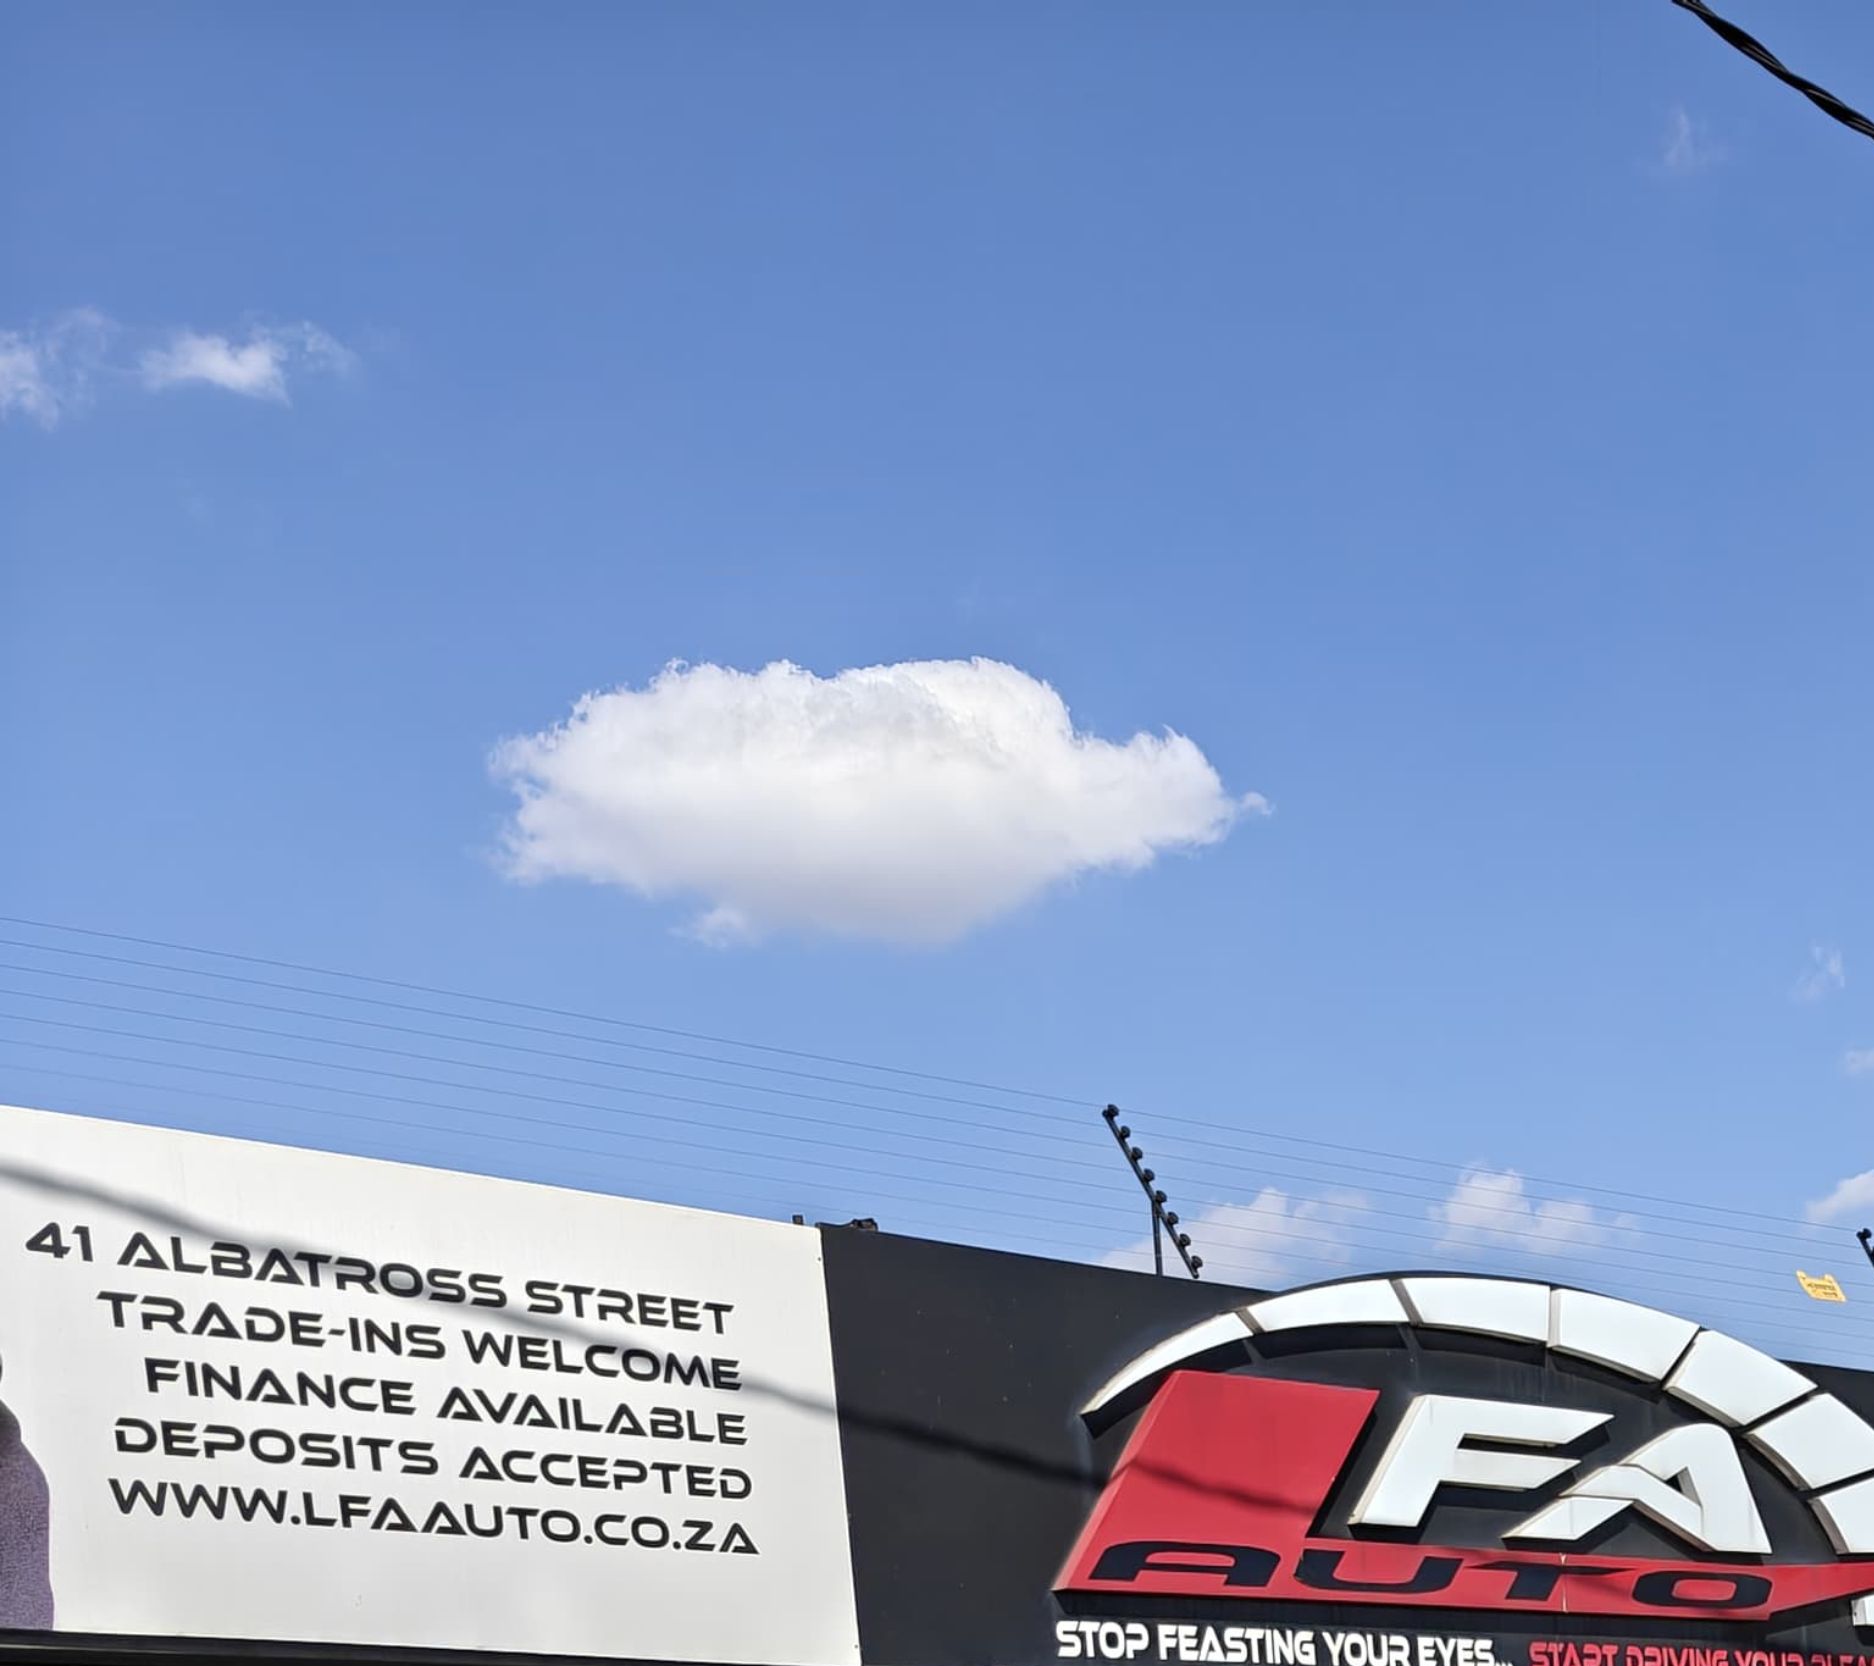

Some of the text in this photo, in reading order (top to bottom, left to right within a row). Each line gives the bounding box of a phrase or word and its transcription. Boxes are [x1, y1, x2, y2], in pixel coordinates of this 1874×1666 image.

[25, 1222, 734, 1334] 41 ALBATROSS STREET
[97, 1291, 743, 1391] TRADE-INS WELCOME
[143, 1356, 748, 1445] FINANCE AVAILABLE
[114, 1417, 753, 1499] DEPOSITS ACCEPTED
[108, 1478, 760, 1555] WWW.LFAAUTO.CO.ZA
[1088, 1541, 1773, 1609] AUTO
[1056, 1621, 1149, 1658] STOP
[1158, 1624, 1317, 1666] FEASTING
